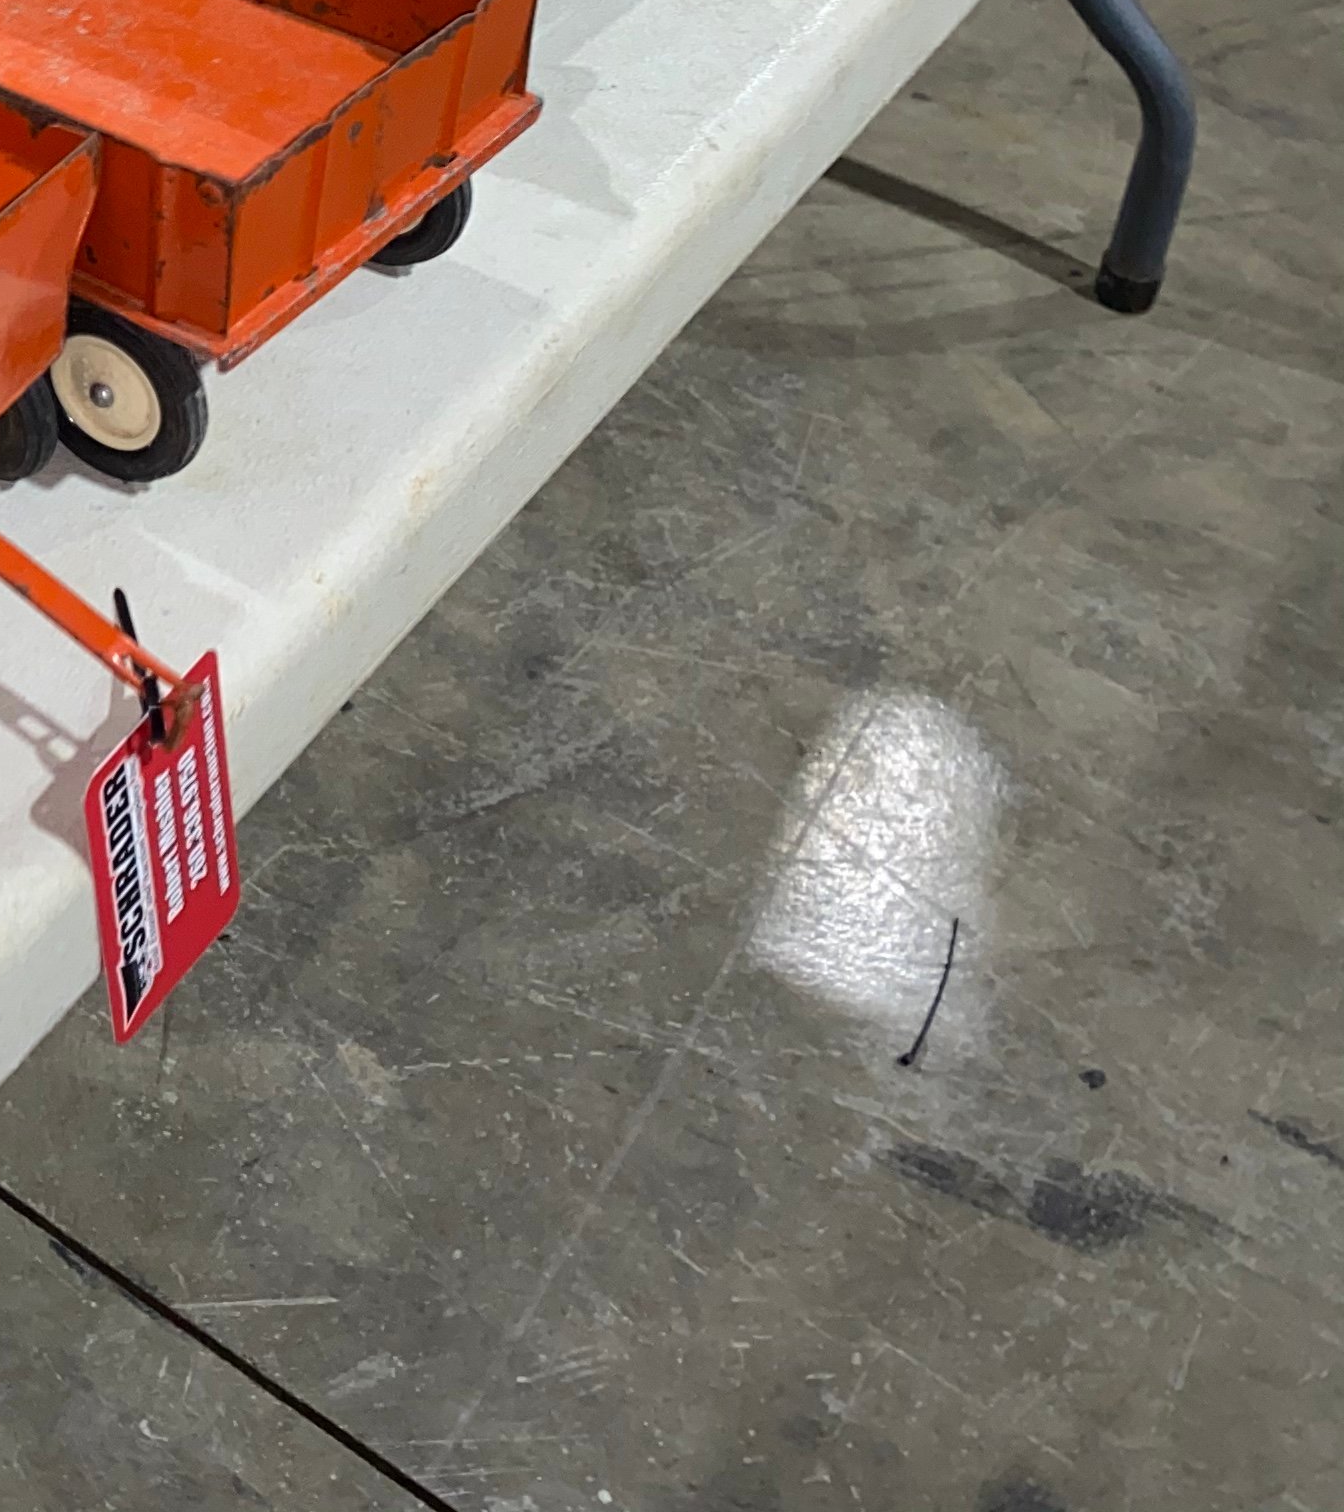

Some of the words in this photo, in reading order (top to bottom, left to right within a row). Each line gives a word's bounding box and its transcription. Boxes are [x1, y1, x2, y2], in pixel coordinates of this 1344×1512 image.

[102, 761, 146, 965] SCHRADER
[154, 767, 178, 858] Mishler
[177, 744, 208, 891] 260.336.9750
[164, 844, 185, 925] Robert
